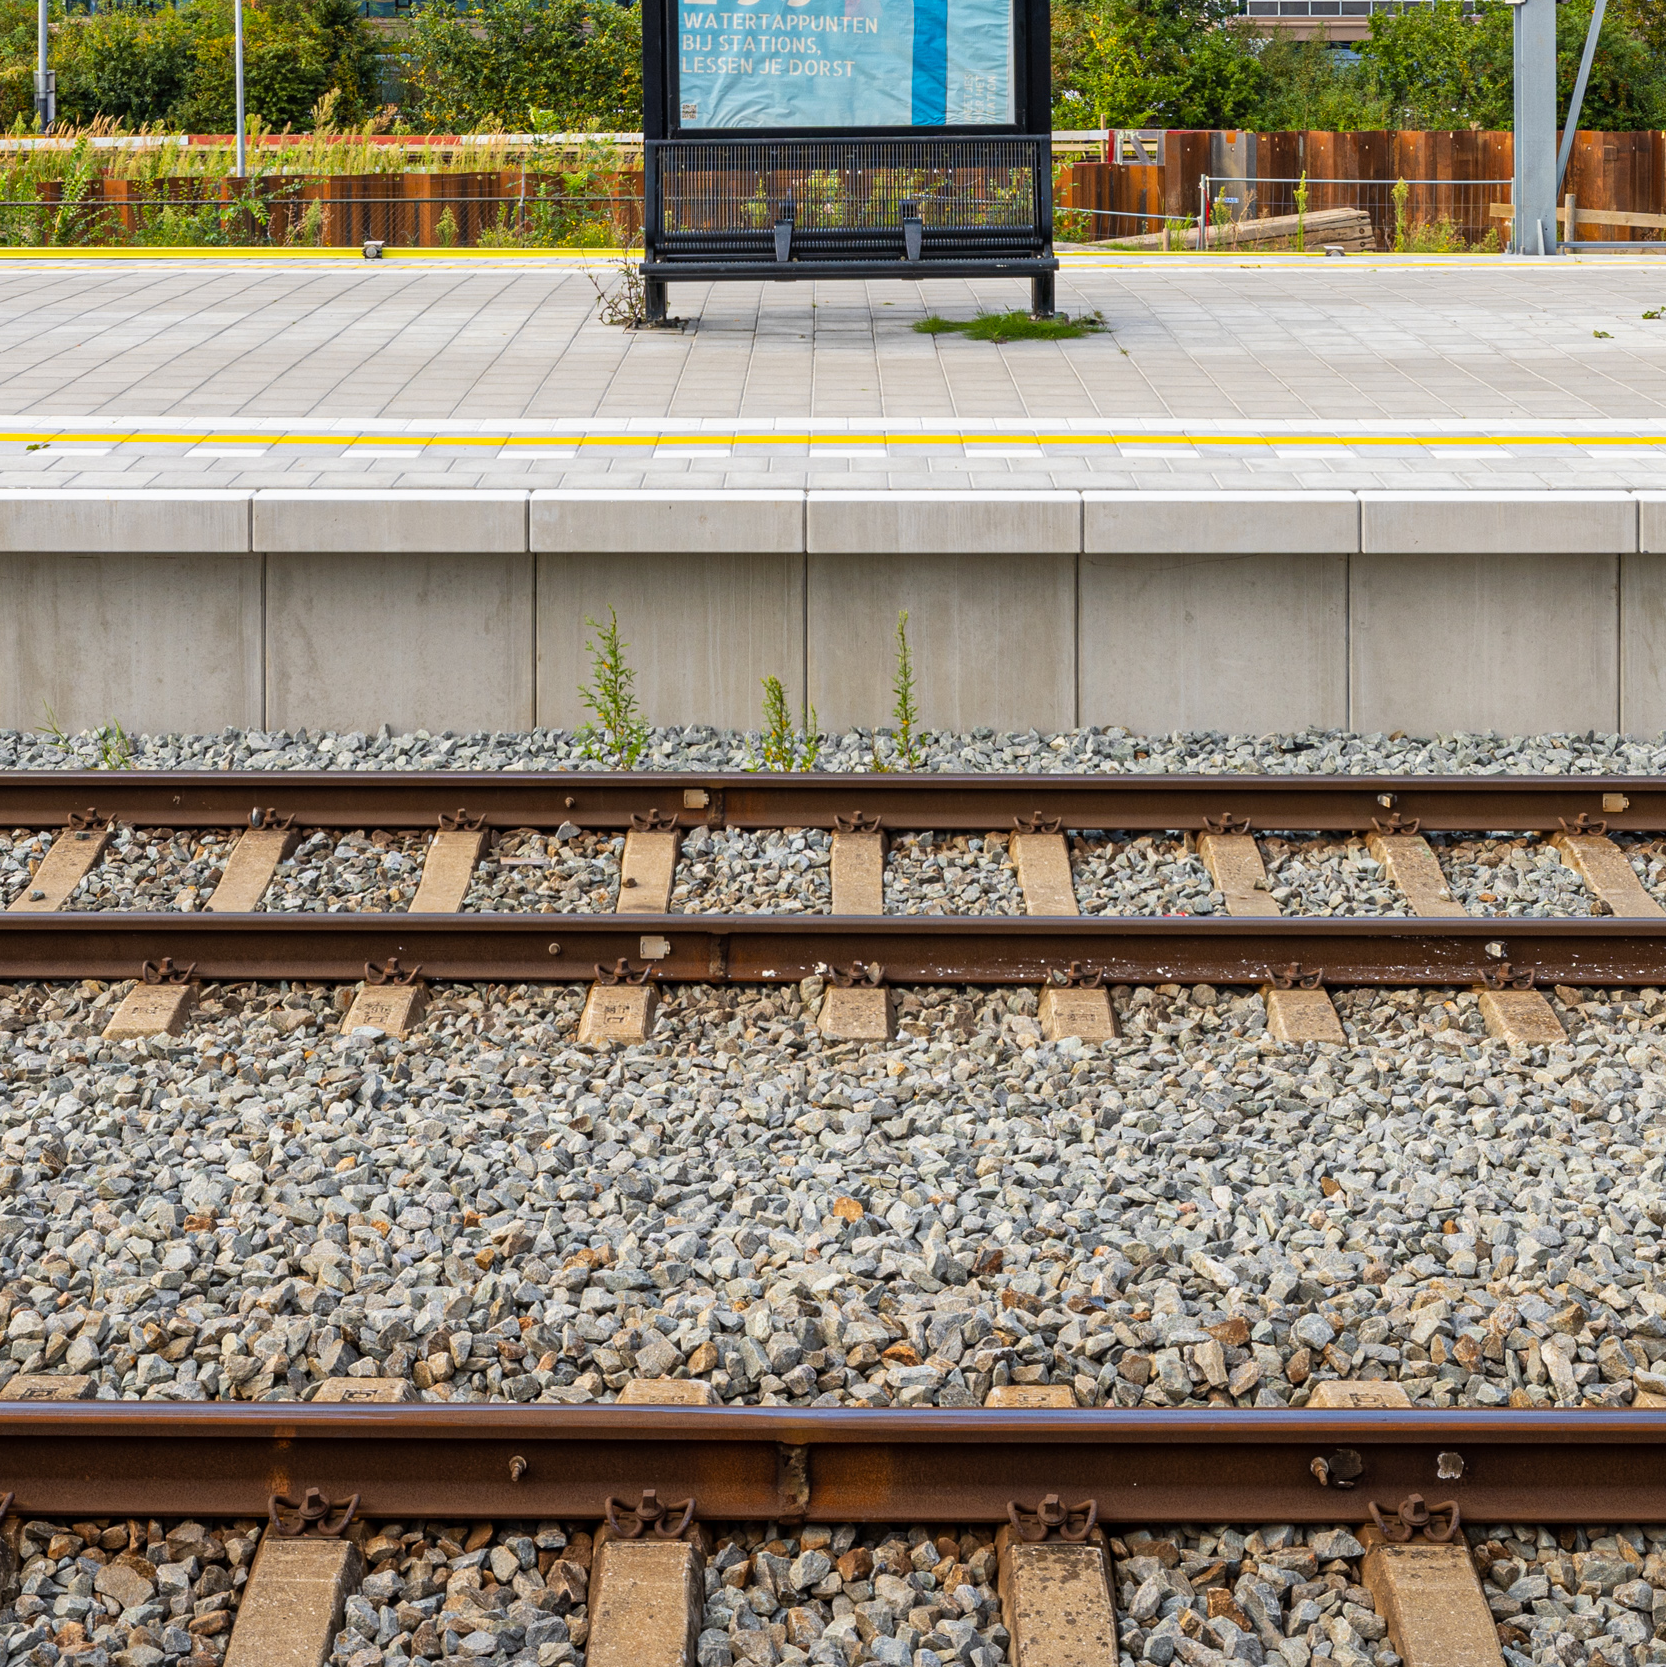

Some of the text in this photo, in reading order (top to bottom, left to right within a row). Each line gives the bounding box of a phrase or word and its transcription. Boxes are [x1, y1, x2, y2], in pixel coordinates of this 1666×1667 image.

[683, 12, 878, 34] WATERTAPPUNTEN
[683, 35, 821, 55] BIJ STATIONS,
[682, 57, 856, 77] LESSEN JE DORST
